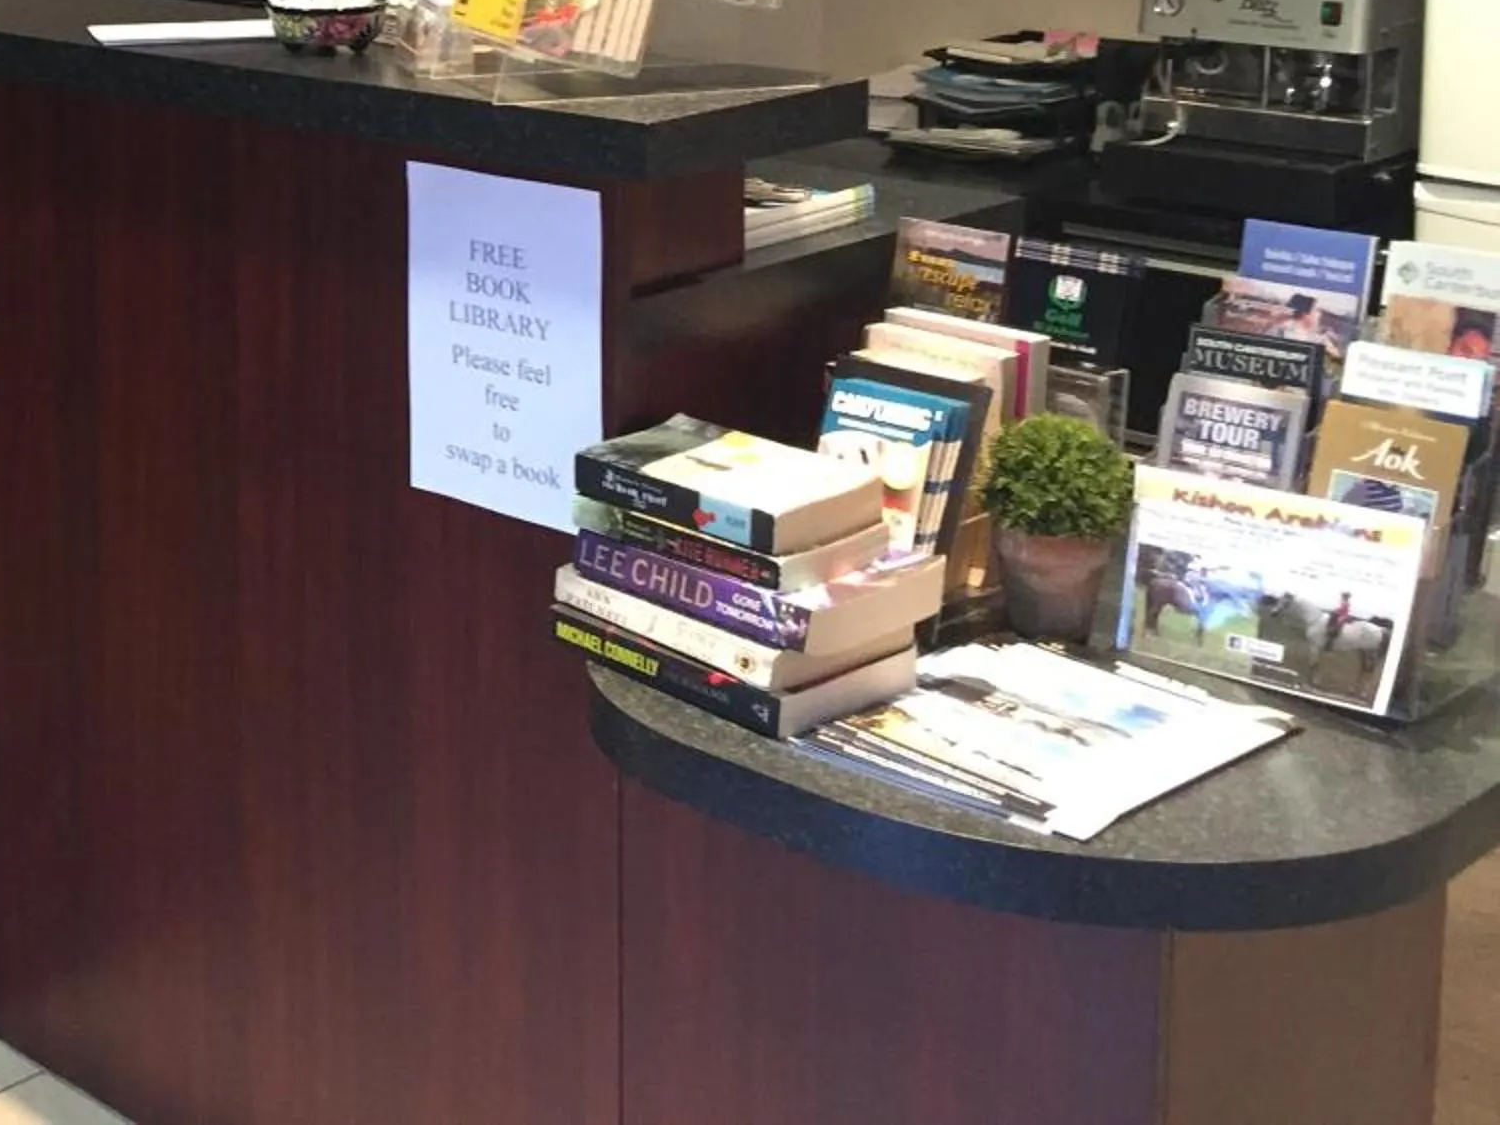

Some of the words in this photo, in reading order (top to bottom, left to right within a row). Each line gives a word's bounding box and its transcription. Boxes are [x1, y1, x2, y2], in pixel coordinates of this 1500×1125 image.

[469, 239, 527, 270] FREE
[465, 272, 532, 305] BOOK
[449, 300, 551, 341] LIBRARY
[451, 343, 510, 376] Please
[518, 358, 552, 386] feel
[1190, 347, 1309, 382] MUSEUM
[484, 384, 520, 412] free
[1184, 398, 1283, 432] BREWERY
[493, 421, 510, 443] to
[1200, 420, 1260, 450] TOUR
[445, 443, 492, 474] swap
[496, 459, 507, 475] a
[512, 456, 561, 490] book
[579, 539, 626, 579] LEE
[631, 558, 714, 609] CHILD
[556, 621, 603, 655] MICHAEL
[604, 641, 660, 676] CONNELLY
